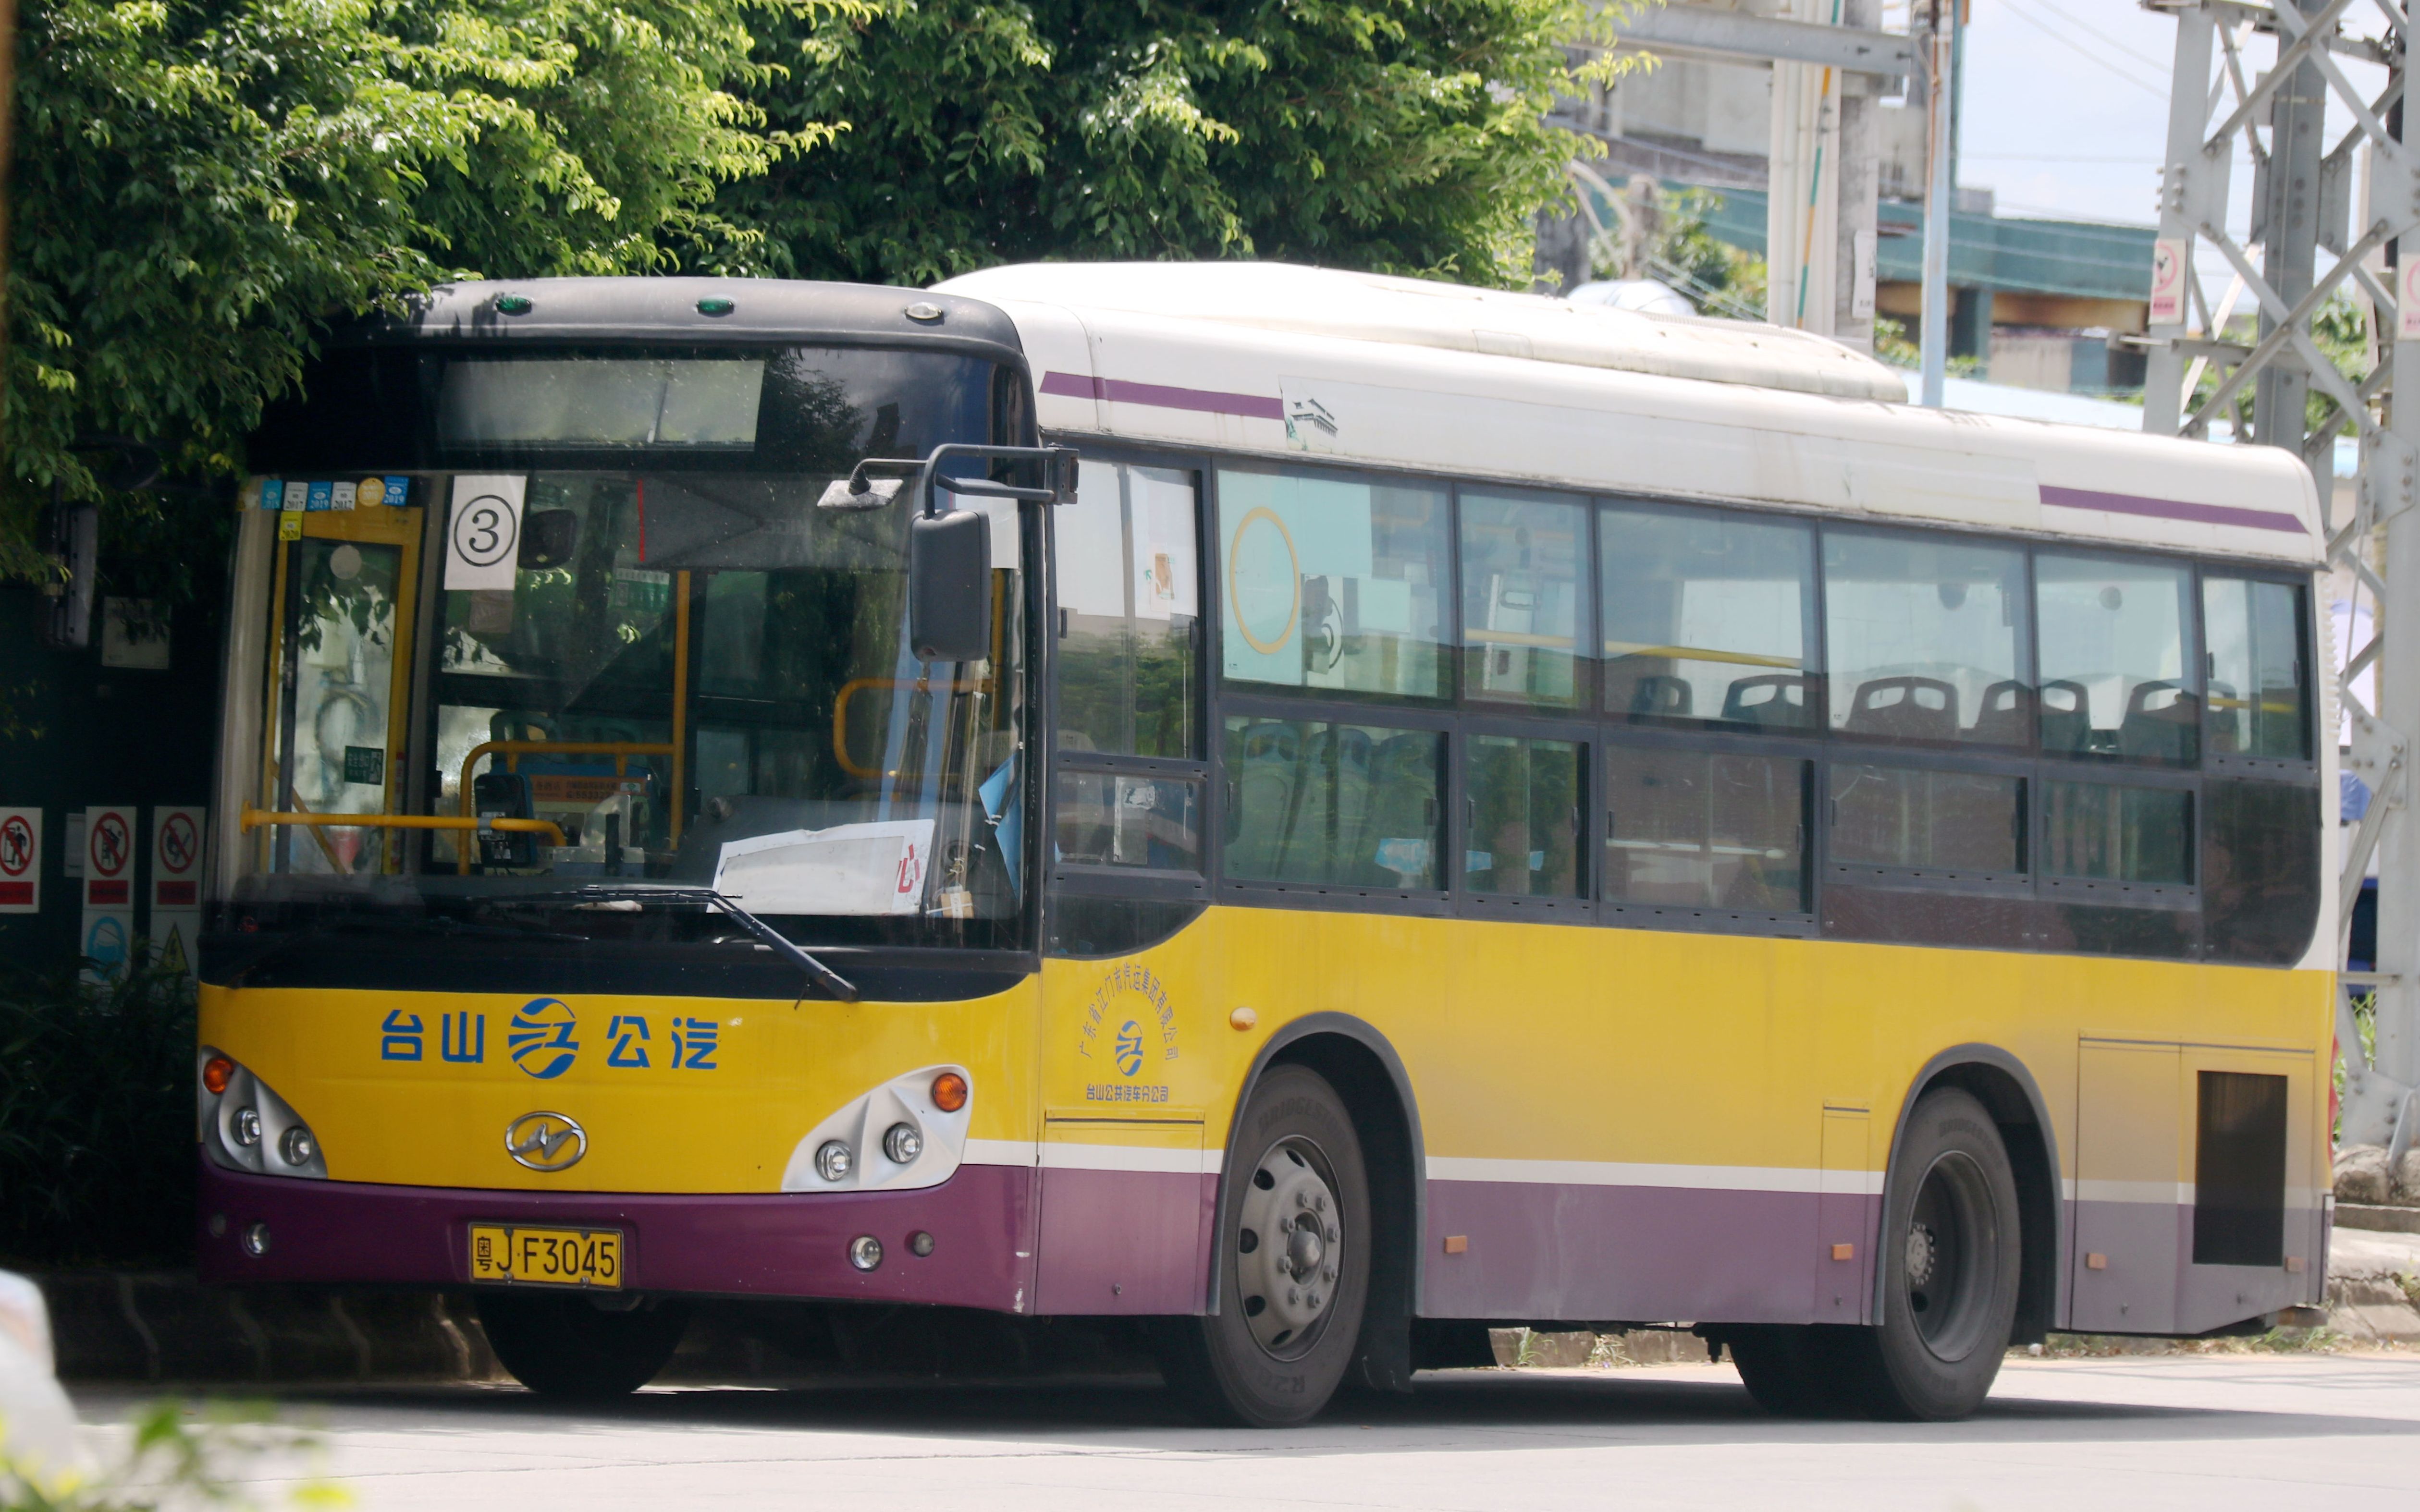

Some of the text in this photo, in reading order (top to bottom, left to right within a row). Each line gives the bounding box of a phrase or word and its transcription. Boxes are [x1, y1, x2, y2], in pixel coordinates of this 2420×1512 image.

[381, 1009, 718, 1070] 台山 公汽
[1079, 962, 1179, 1060] 广东省江门市汽运集团有限公司
[1086, 1083, 1168, 1103] 台山公共汽车分公司
